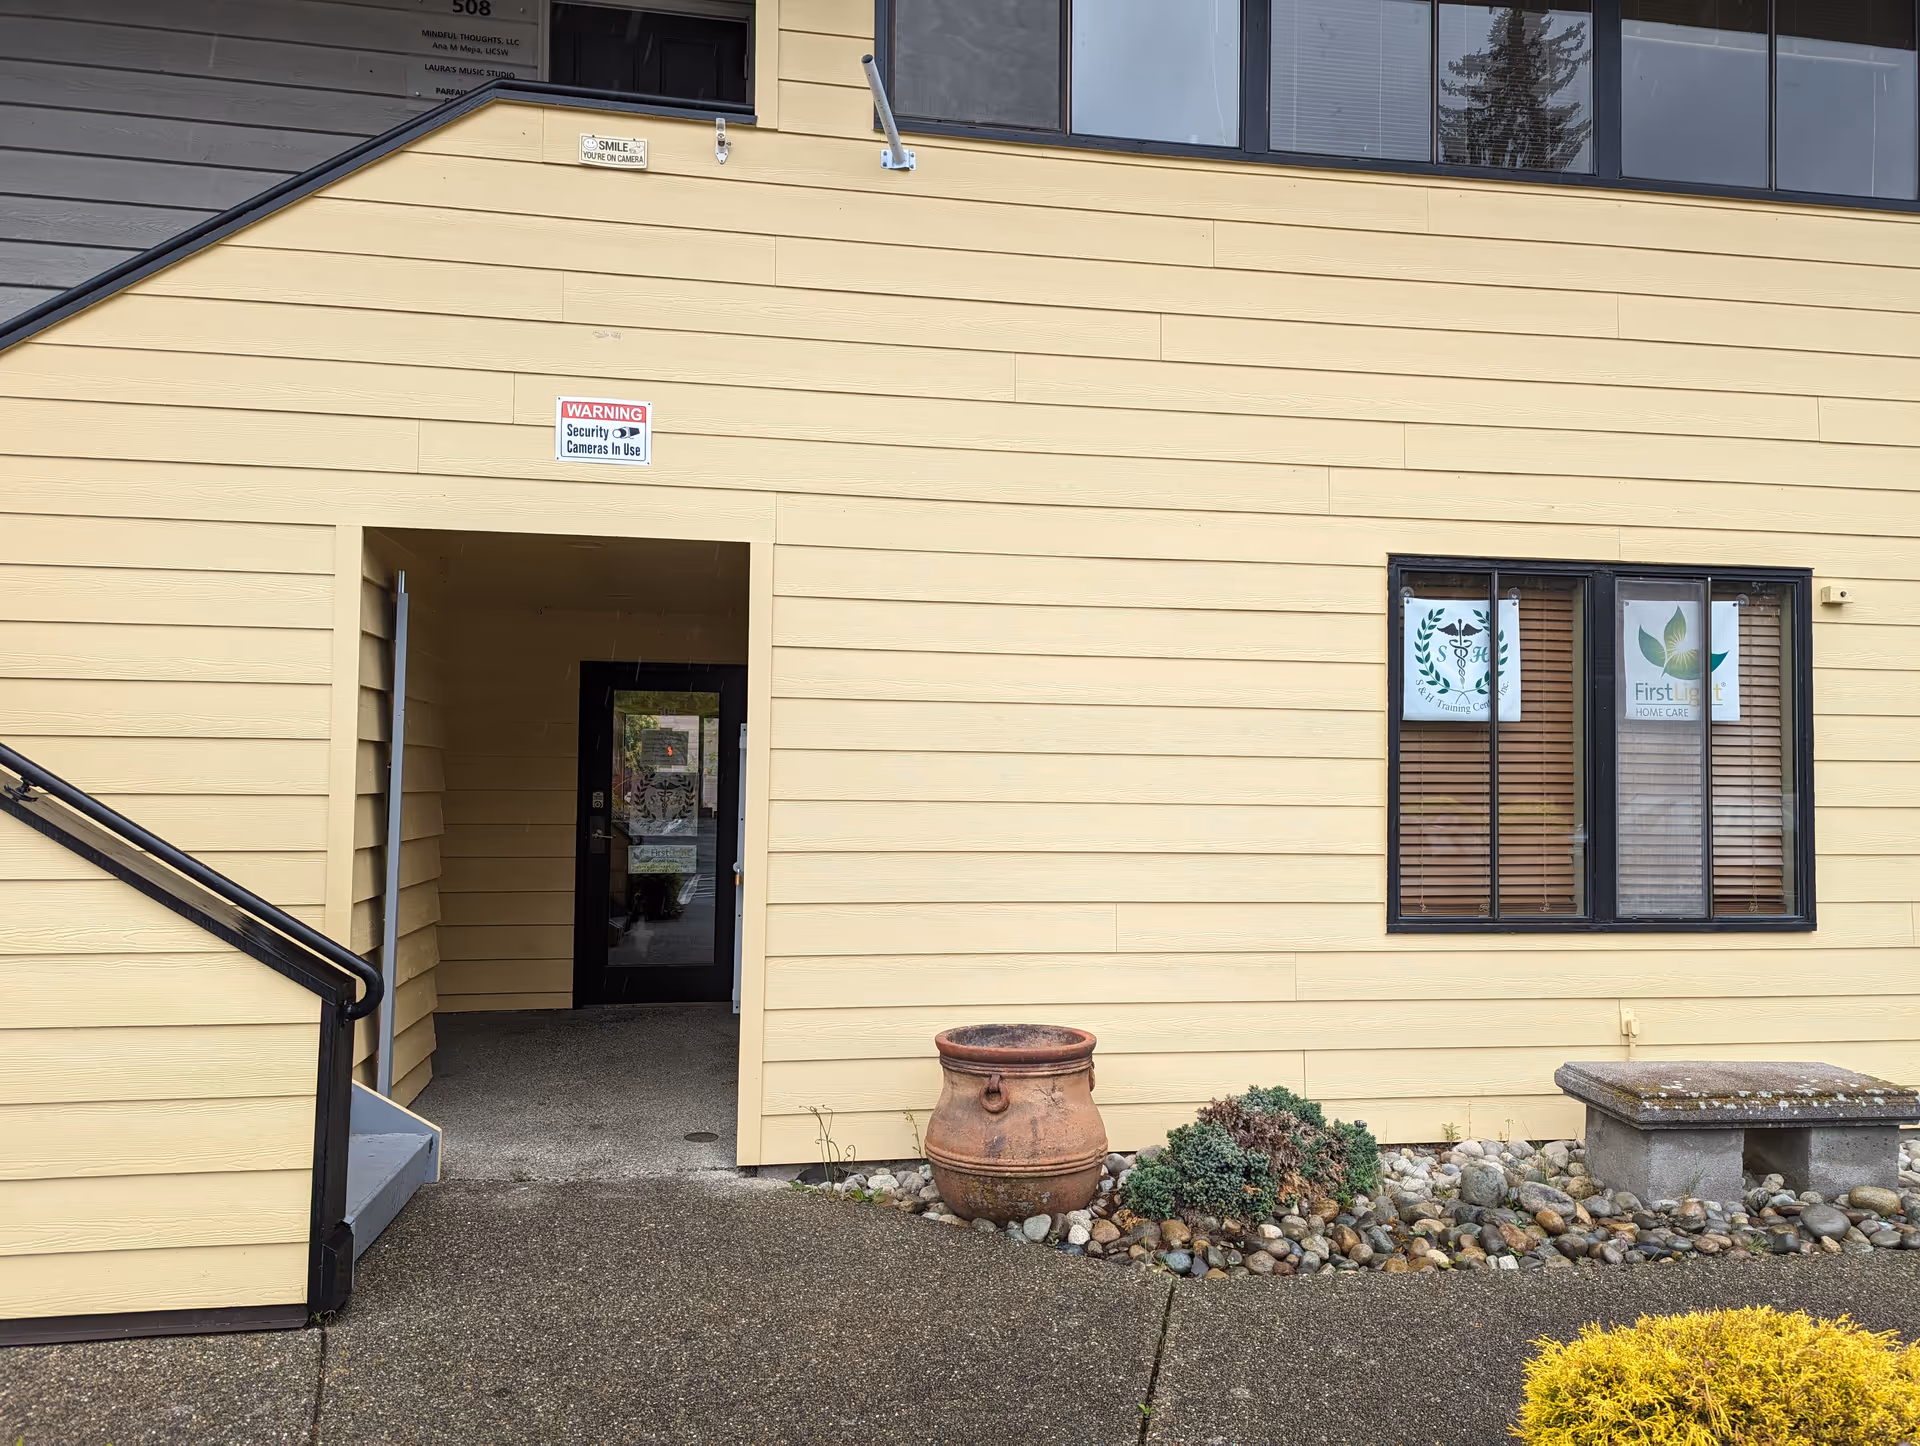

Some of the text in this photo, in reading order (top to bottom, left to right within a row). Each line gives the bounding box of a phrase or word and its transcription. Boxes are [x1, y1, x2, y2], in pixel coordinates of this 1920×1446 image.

[452, 0, 491, 16] 508
[422, 30, 457, 40] MINDFUL
[506, 38, 520, 46] LLC
[432, 42, 448, 50] Ana
[449, 43, 458, 51] M
[485, 47, 509, 56] LICSW
[424, 63, 515, 79] LAURA'S MUSIC STUDIO
[599, 140, 629, 153] SMILE
[583, 150, 644, 164] YOU'RE ON CAMERA
[566, 403, 643, 421] WARNING
[566, 423, 609, 441] Security
[566, 440, 641, 457] Cameras In Use
[1418, 687, 1426, 696] &
[1425, 693, 1435, 703] H
[1436, 698, 1471, 714] Training
[1498, 681, 1510, 696] Inc.
[1635, 682, 1723, 707] FirstLigt
[1635, 708, 1689, 717] HOME CARE
